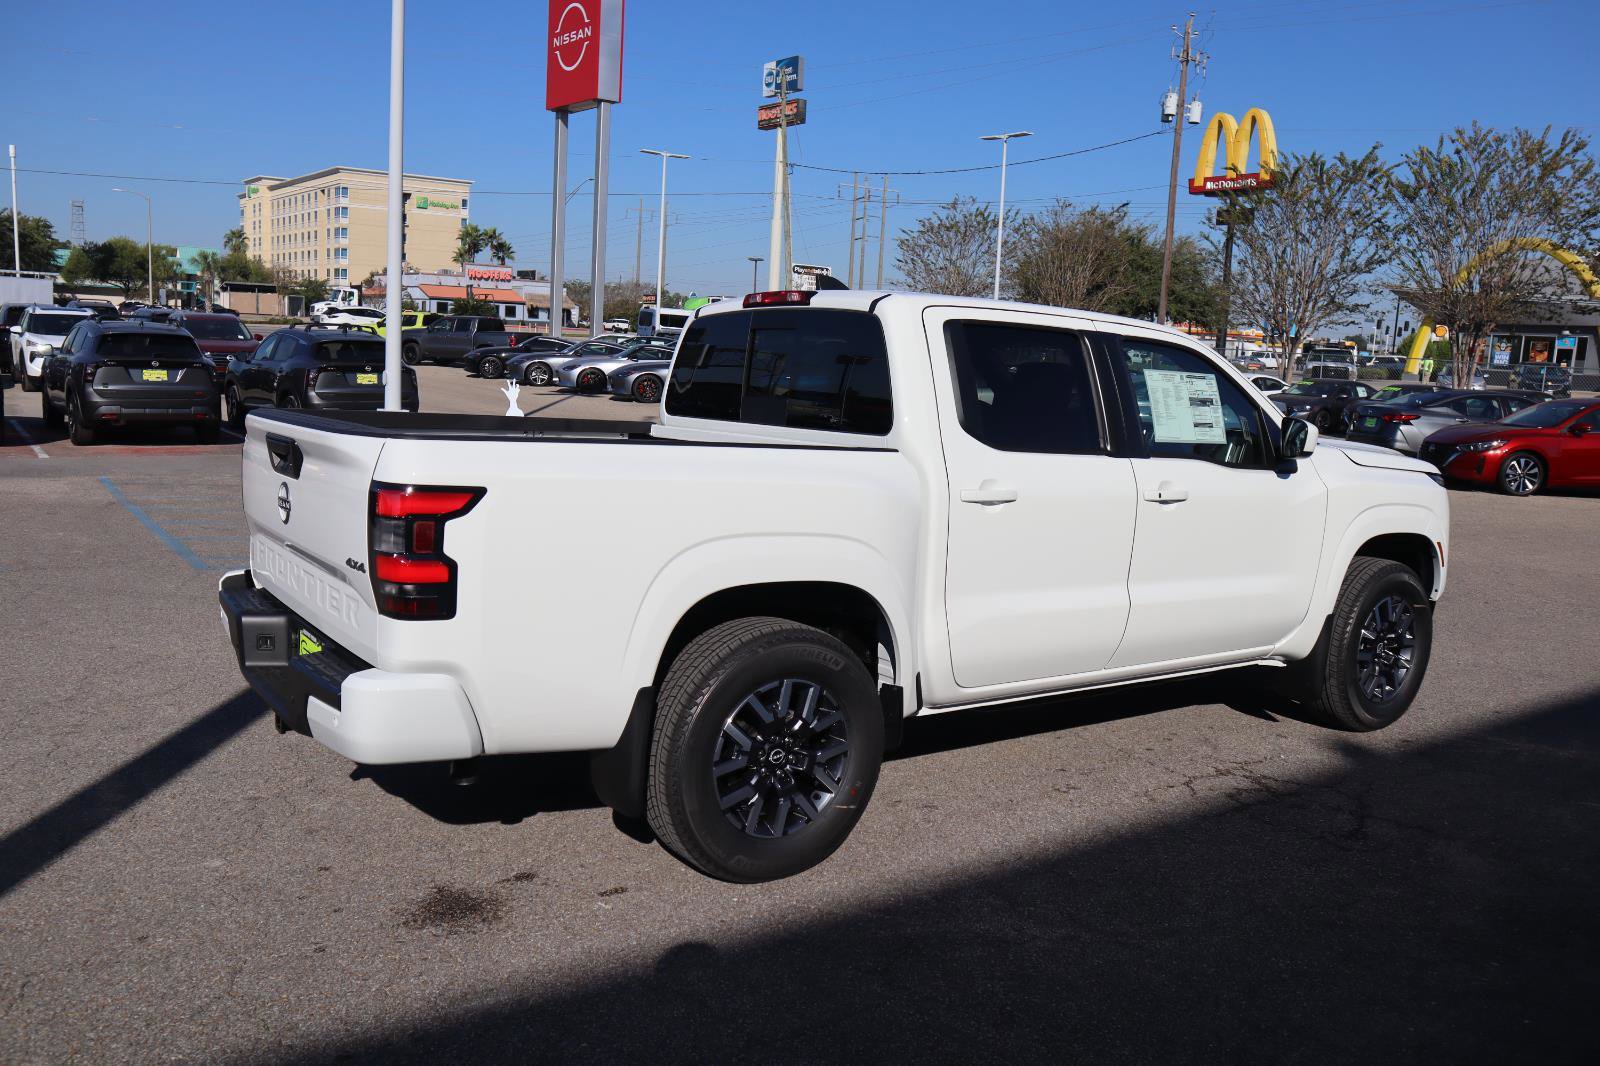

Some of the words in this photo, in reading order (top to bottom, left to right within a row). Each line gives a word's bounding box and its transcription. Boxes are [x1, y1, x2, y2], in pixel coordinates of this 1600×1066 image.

[553, 26, 592, 47] NISSAN
[429, 200, 449, 210] Holiday
[450, 202, 459, 210] Inn
[468, 268, 512, 281] HOOTERS
[256, 540, 361, 631] FRONTIER
